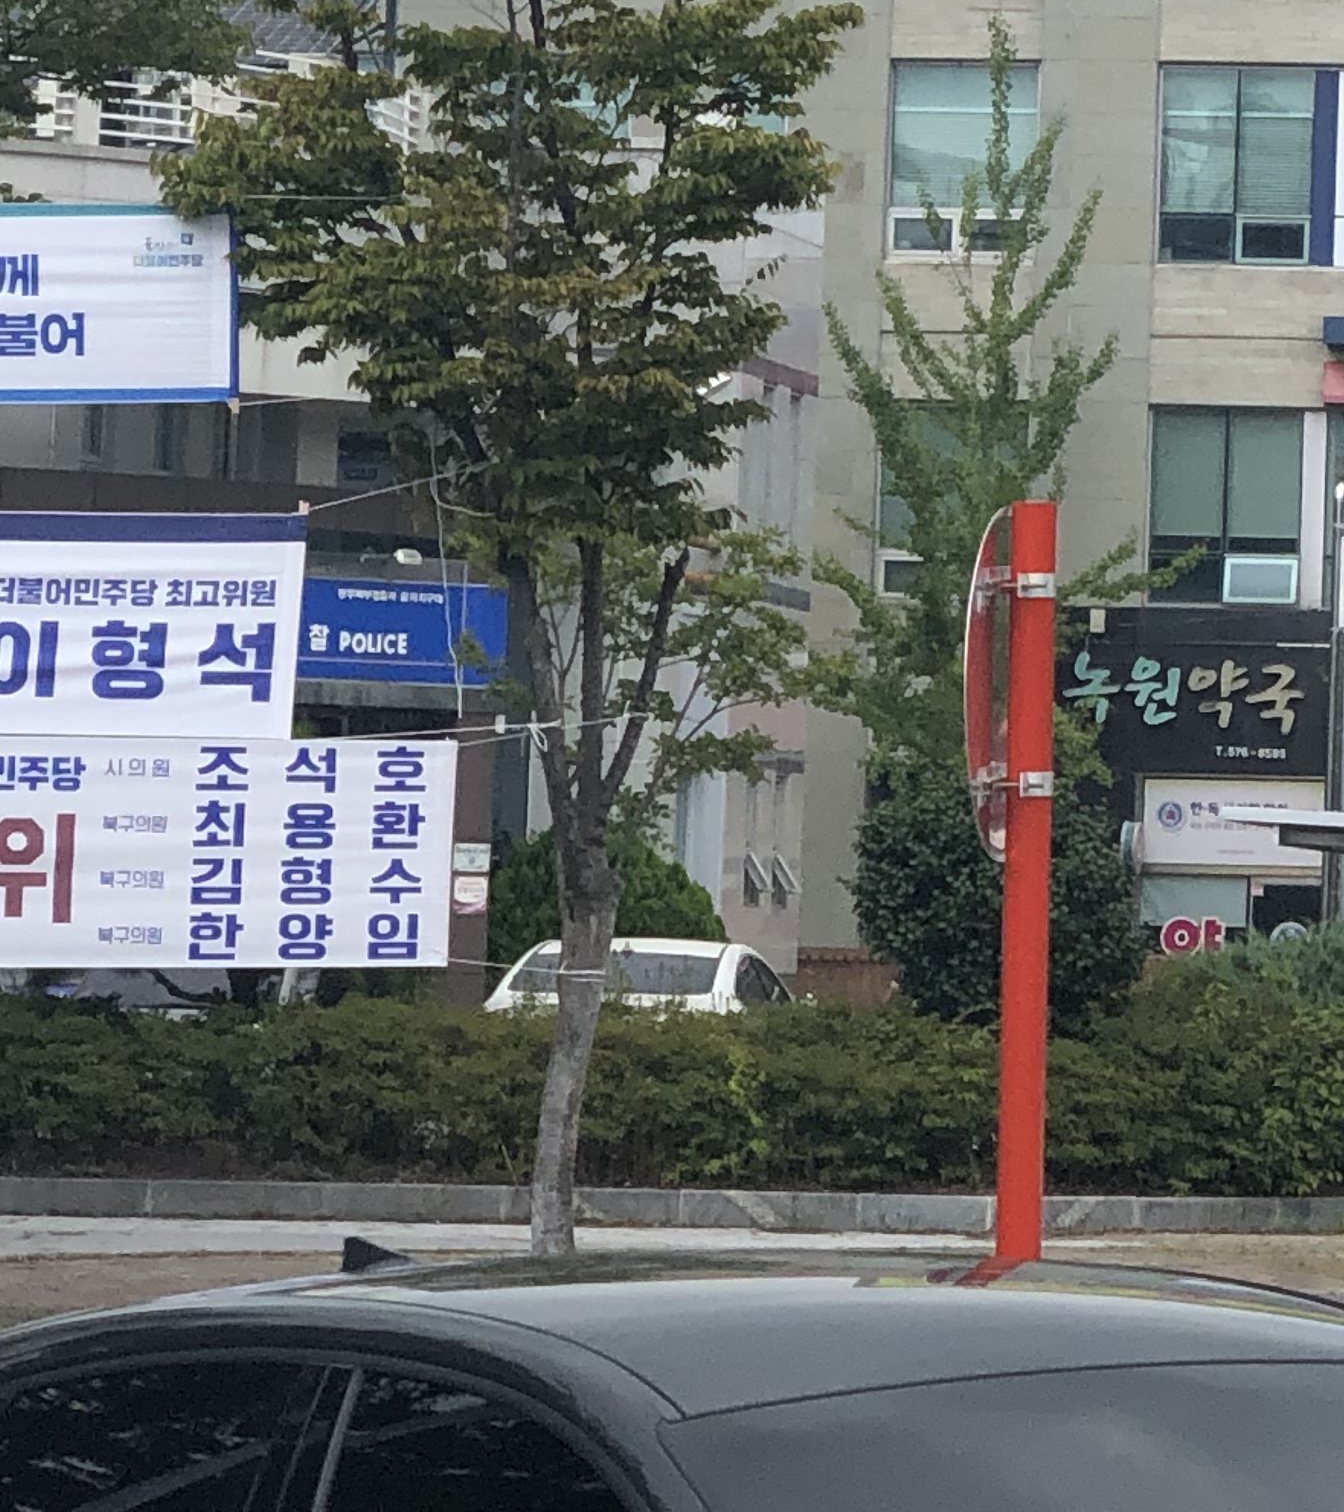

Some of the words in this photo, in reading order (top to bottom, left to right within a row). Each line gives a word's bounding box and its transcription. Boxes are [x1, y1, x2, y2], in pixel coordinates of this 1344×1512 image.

[165, 578, 277, 608] 최고위원
[0, 619, 277, 704] 이형석
[338, 630, 408, 655] POLICE
[1062, 650, 1305, 736] 녹원약국
[105, 757, 171, 779] 시의원
[195, 745, 428, 794] 조석호
[102, 814, 169, 834] 북구의원
[192, 799, 427, 851] 최용환
[100, 869, 166, 889] 북구의원
[188, 856, 423, 906] 김형수
[98, 925, 163, 946] 북구의원
[187, 911, 420, 961] 한양임
